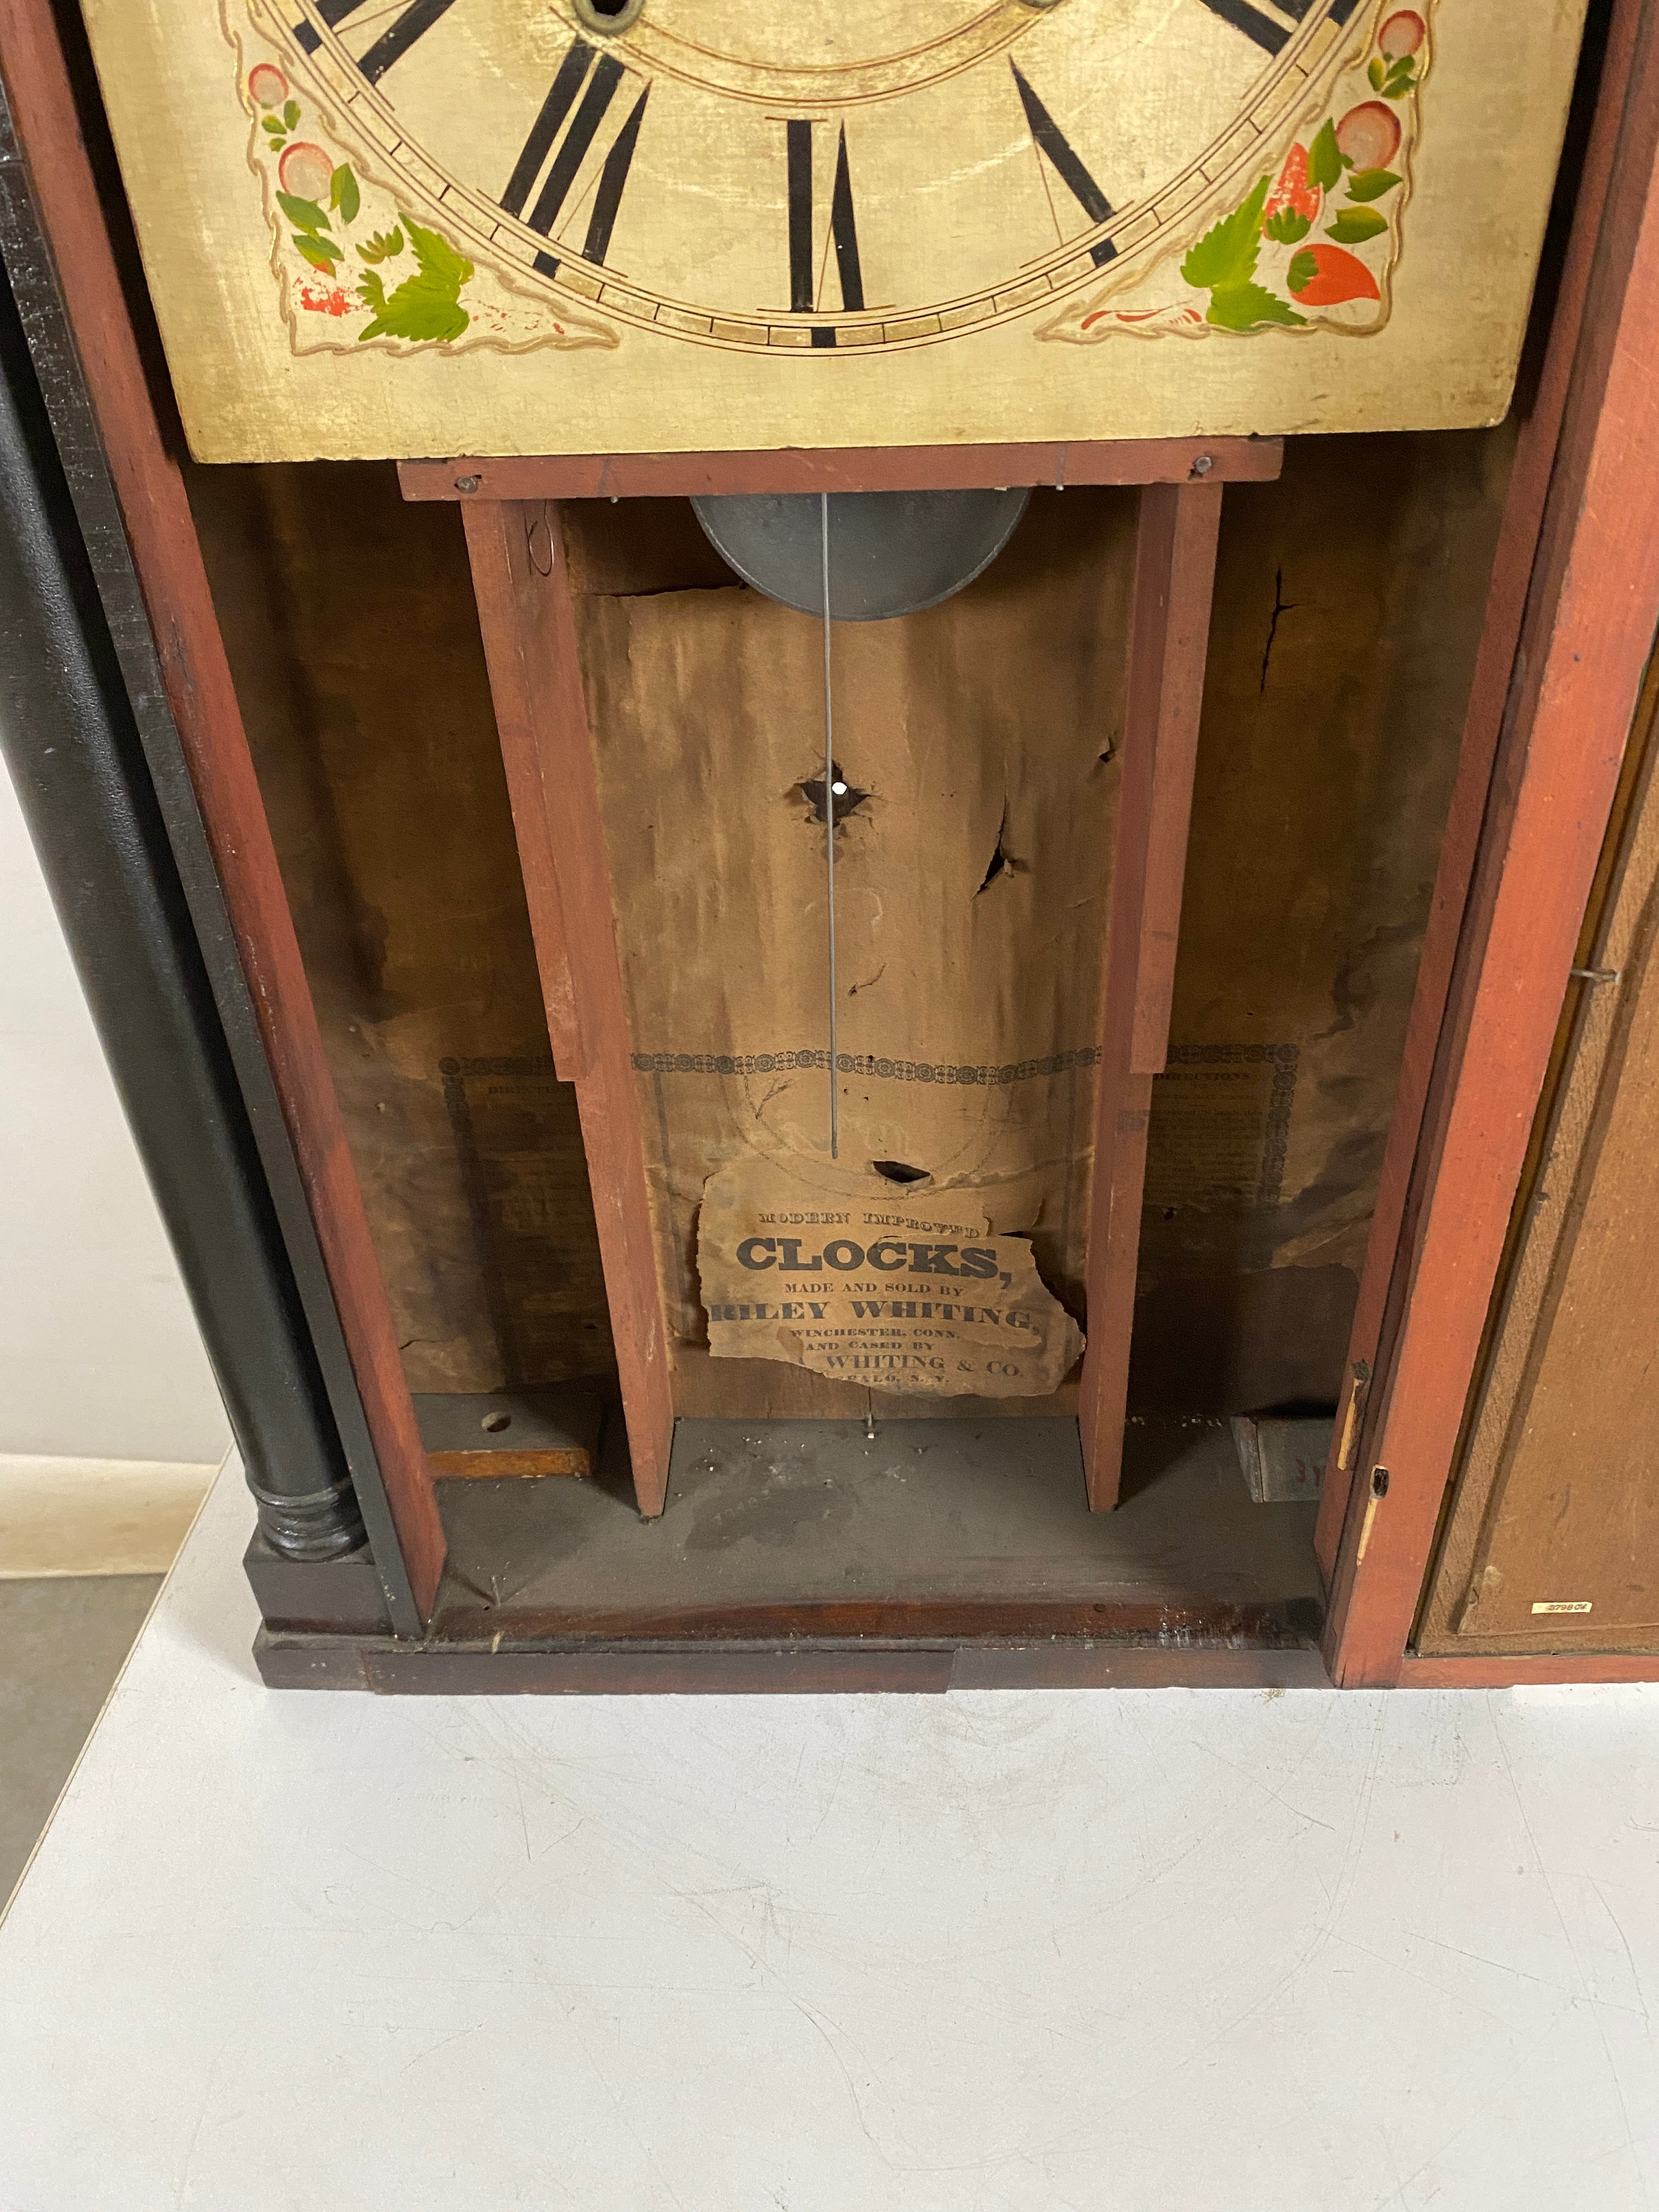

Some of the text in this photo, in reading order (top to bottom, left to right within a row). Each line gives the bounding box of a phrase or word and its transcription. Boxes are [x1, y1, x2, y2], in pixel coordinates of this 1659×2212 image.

[759, 1212, 980, 1239] MODERN IMPROVED
[736, 1237, 1012, 1290] CLOCKS,
[785, 1283, 964, 1297] MADE AND SOLD BY
[710, 1301, 1042, 1335] RILEY WHITING,
[805, 1341, 935, 1351] AND CASED BY
[826, 1355, 1024, 1378] WHITING & CO.
